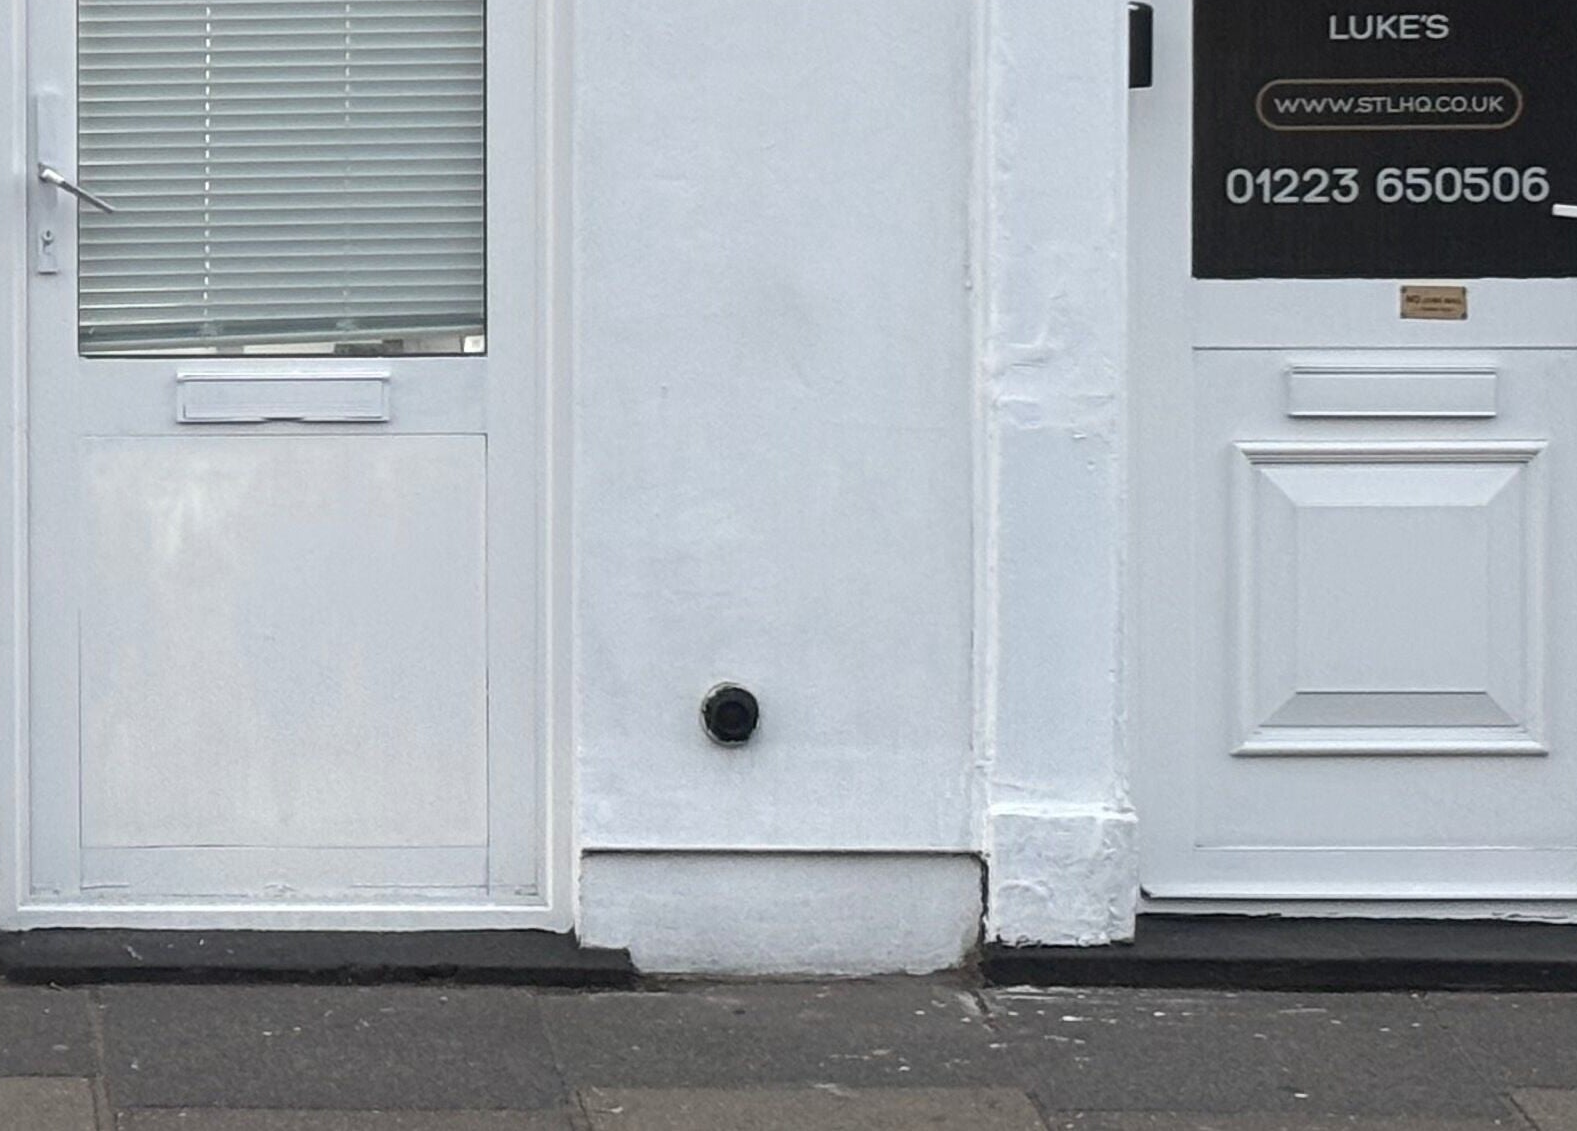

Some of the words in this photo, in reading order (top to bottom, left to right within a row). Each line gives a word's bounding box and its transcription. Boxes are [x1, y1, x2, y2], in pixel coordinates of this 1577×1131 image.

[1329, 14, 1450, 40] LUKE'S
[1274, 95, 1504, 114] WWW.STLHQ.CO.UK
[1226, 168, 1359, 204] 01223
[1376, 167, 1550, 203] 650506
